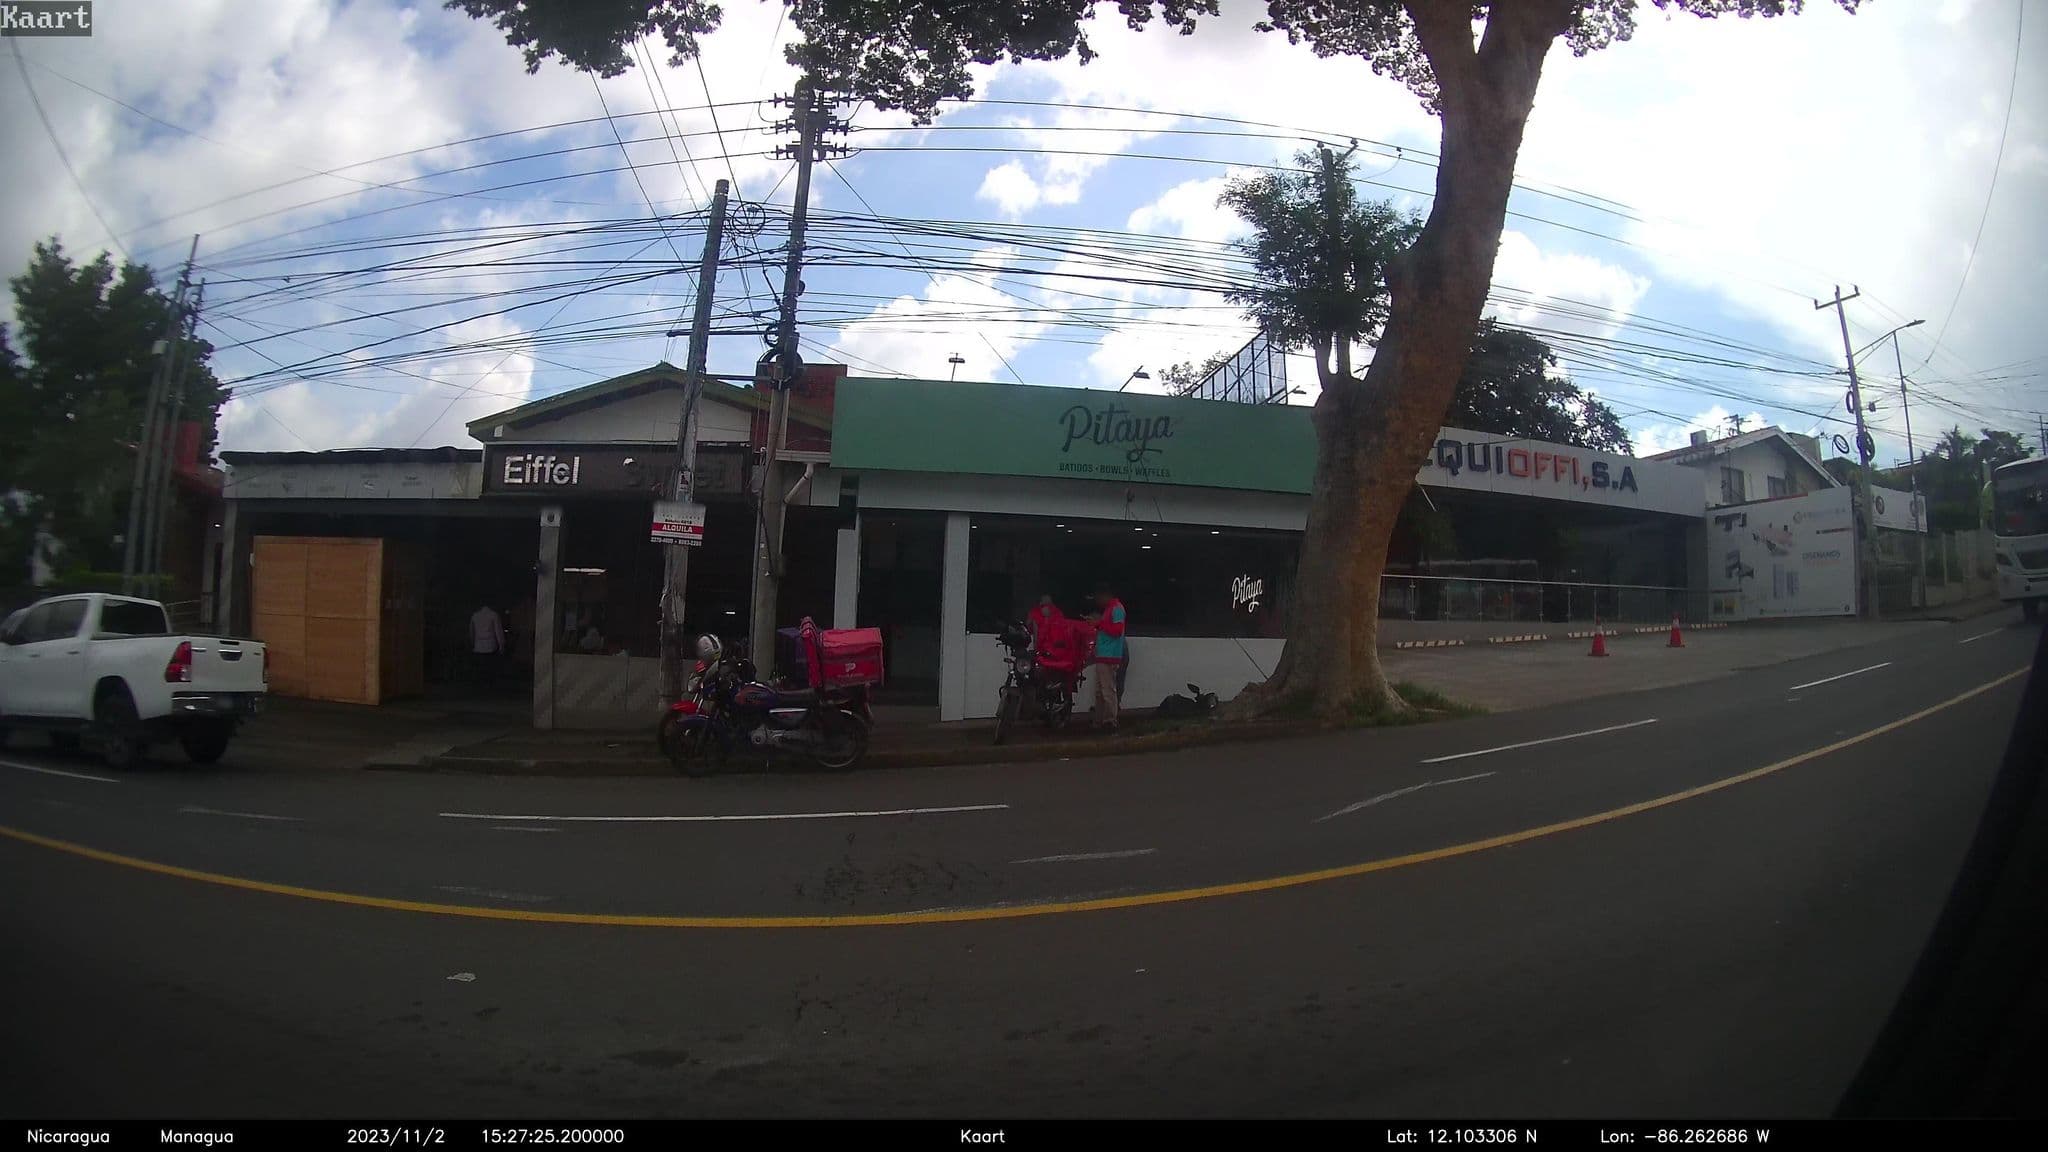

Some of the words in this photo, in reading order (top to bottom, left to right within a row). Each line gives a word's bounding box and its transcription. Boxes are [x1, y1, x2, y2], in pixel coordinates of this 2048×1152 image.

[1059, 402, 1173, 462] Pitaya
[504, 454, 580, 484] Eiffel
[1060, 462, 1093, 473] BATIDOS
[1100, 464, 1129, 474] BOWLS
[1135, 466, 1170, 478] WAFFLES
[1425, 439, 1638, 493] QUIOFFI,S.A
[662, 524, 693, 533] ALQUILA
[1232, 574, 1263, 613] Pitaya
